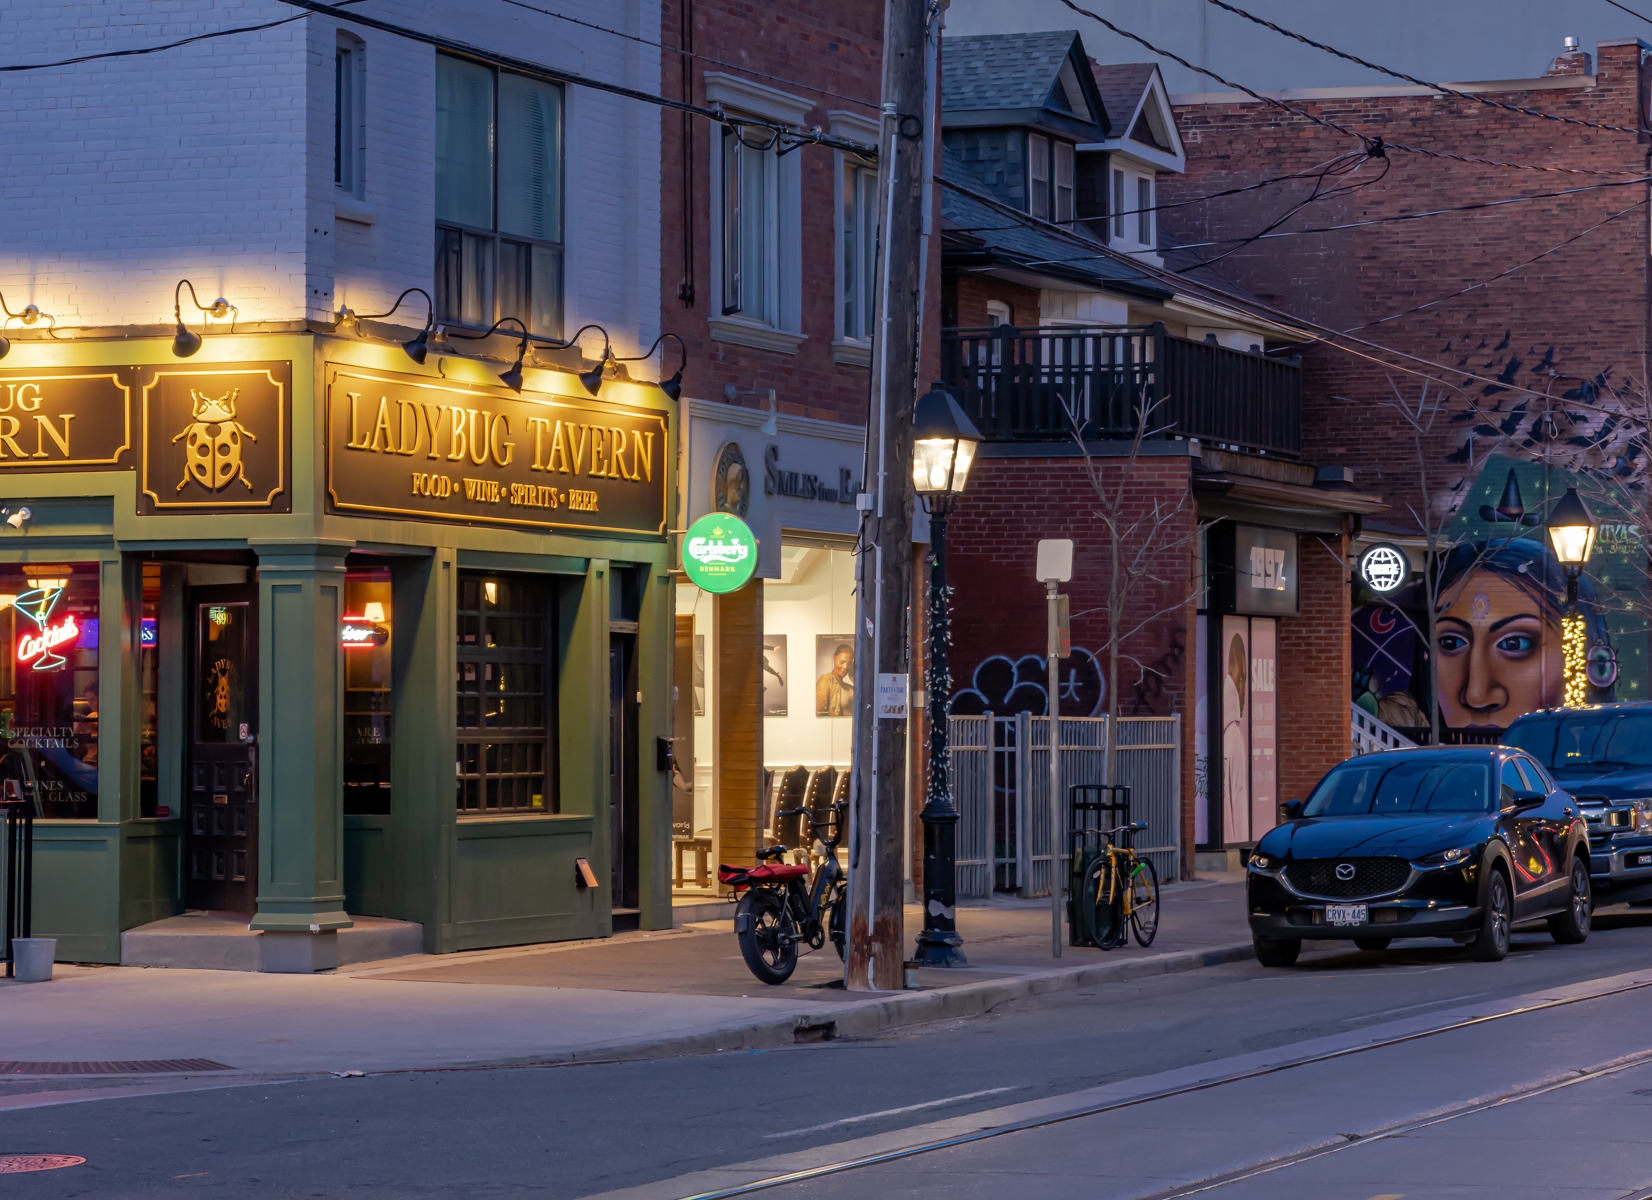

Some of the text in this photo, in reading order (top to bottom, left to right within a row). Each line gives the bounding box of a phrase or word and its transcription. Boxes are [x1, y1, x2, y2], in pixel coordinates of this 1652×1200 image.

[347, 392, 655, 482] LADYBUG TAVERN
[411, 472, 599, 512] FOOD WINE SPIRITS BEER
[688, 537, 748, 561] Carlsberg
[17, 614, 79, 661] Cocktails
[1251, 658, 1274, 692] SALE
[7, 738, 80, 749] COCKTAILS
[9, 726, 75, 737] SPECIALTY
[48, 791, 88, 802] GLASS
